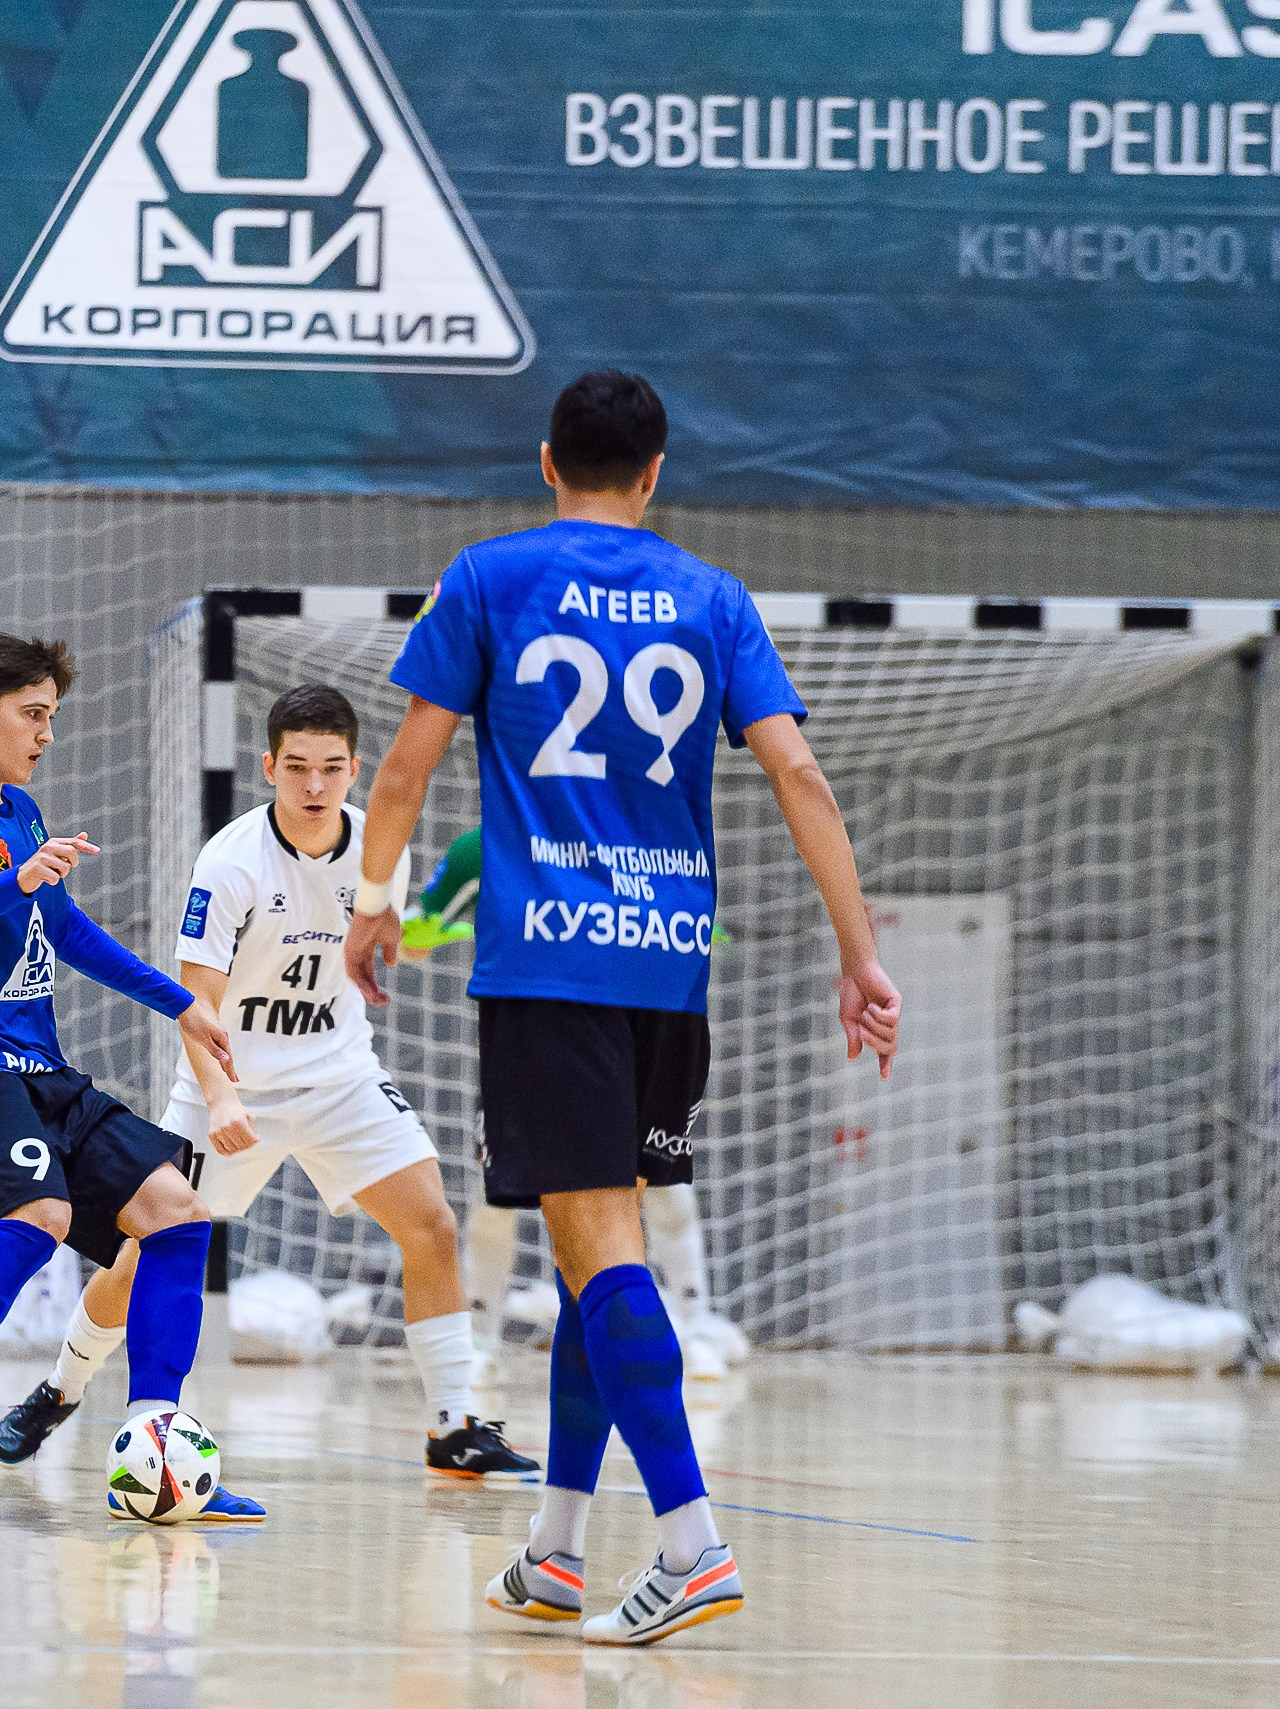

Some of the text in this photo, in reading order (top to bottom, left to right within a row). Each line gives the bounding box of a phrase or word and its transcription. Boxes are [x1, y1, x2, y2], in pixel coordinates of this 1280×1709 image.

[565, 92, 1280, 176] ВЗВЕШЕННОЕ РЕШЕ
[140, 204, 383, 289] АСИ
[957, 223, 1256, 290] КЕМЕРОВО,
[41, 303, 478, 346] КОРПОРАЦИЯ
[558, 581, 678, 624] АГЕЕВ
[514, 634, 706, 788] 29
[610, 869, 656, 902] КЛУБ
[523, 899, 712, 957] КУЗБАСС
[281, 954, 322, 991] 41
[10, 1137, 51, 1181] 9
